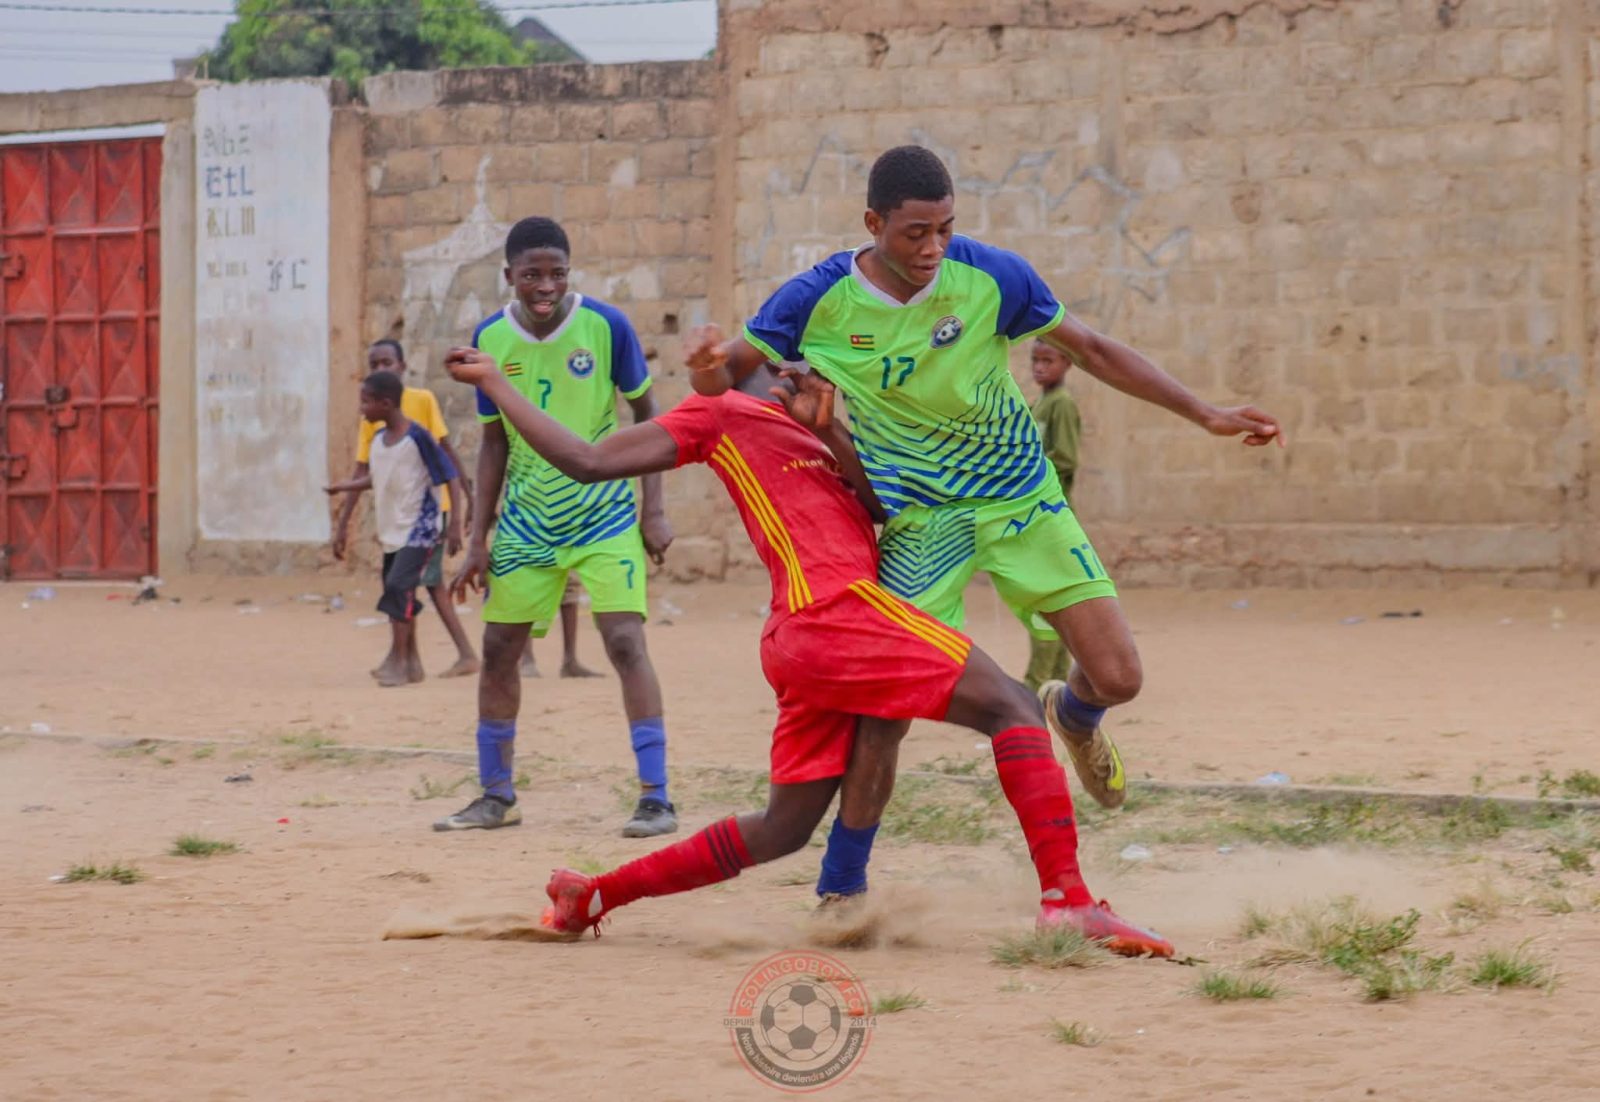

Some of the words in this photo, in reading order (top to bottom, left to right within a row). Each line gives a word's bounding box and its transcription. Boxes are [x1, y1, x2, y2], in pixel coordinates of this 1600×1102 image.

[881, 356, 915, 390] 17
[538, 379, 552, 410] 7
[619, 559, 635, 590] 7
